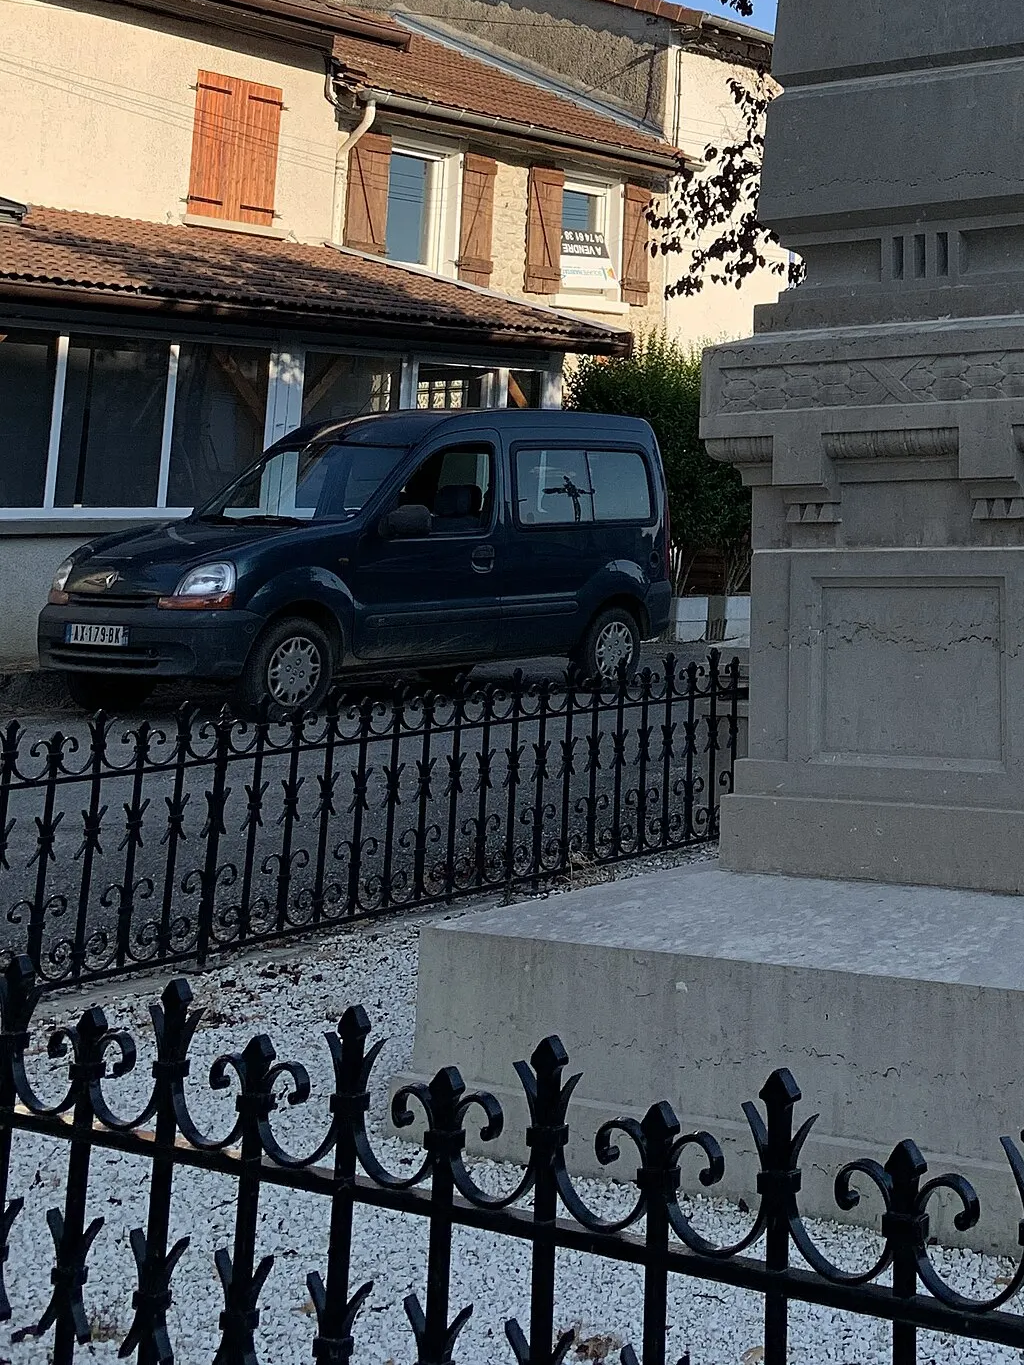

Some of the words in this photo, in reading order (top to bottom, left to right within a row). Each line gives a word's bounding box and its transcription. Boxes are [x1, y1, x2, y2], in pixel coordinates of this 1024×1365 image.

[575, 231, 585, 242] 61
[584, 233, 595, 243] 74
[594, 234, 604, 244] 04
[562, 243, 595, 255] VENDRE
[73, 625, 121, 645] AX-179-BK
